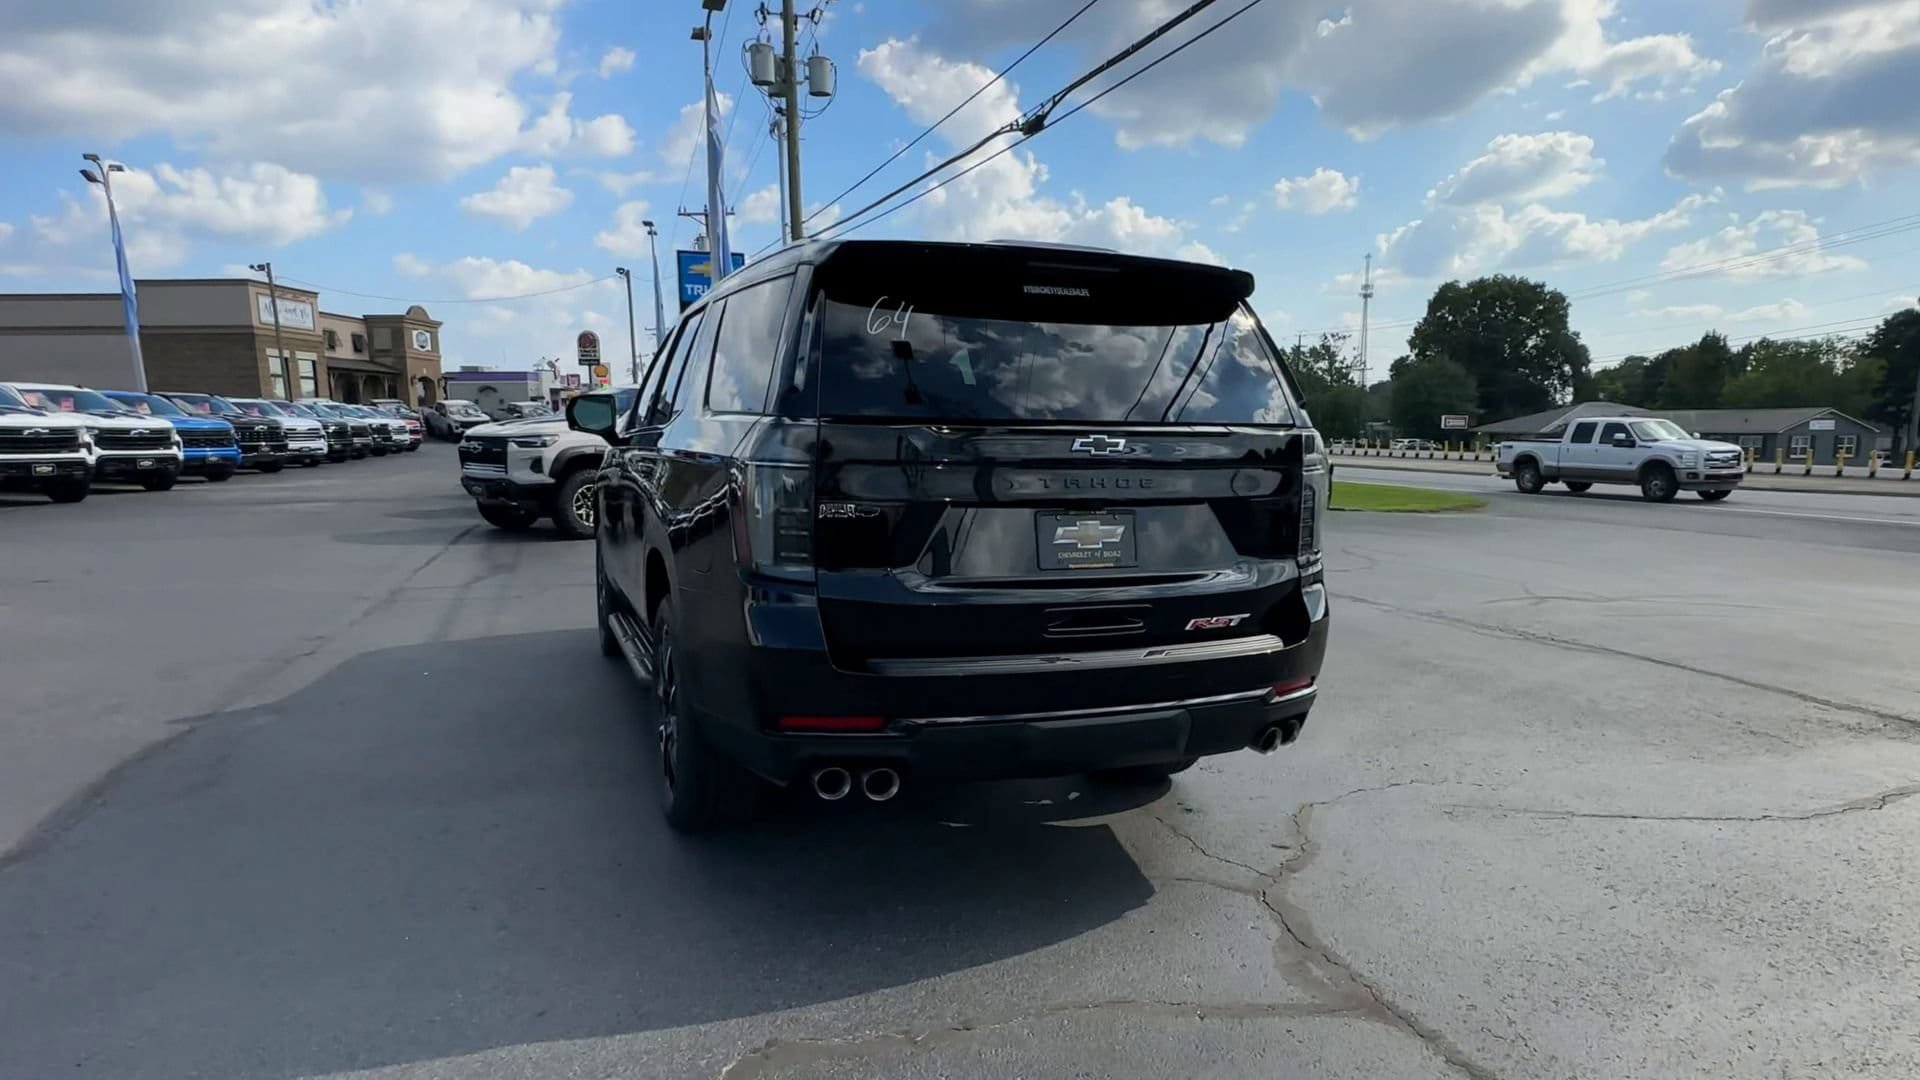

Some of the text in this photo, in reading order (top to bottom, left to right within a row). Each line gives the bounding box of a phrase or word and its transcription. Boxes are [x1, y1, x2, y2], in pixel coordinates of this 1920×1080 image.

[866, 295, 914, 341] 64
[1037, 477, 1153, 489] TAHOE
[1184, 612, 1252, 631] RST
